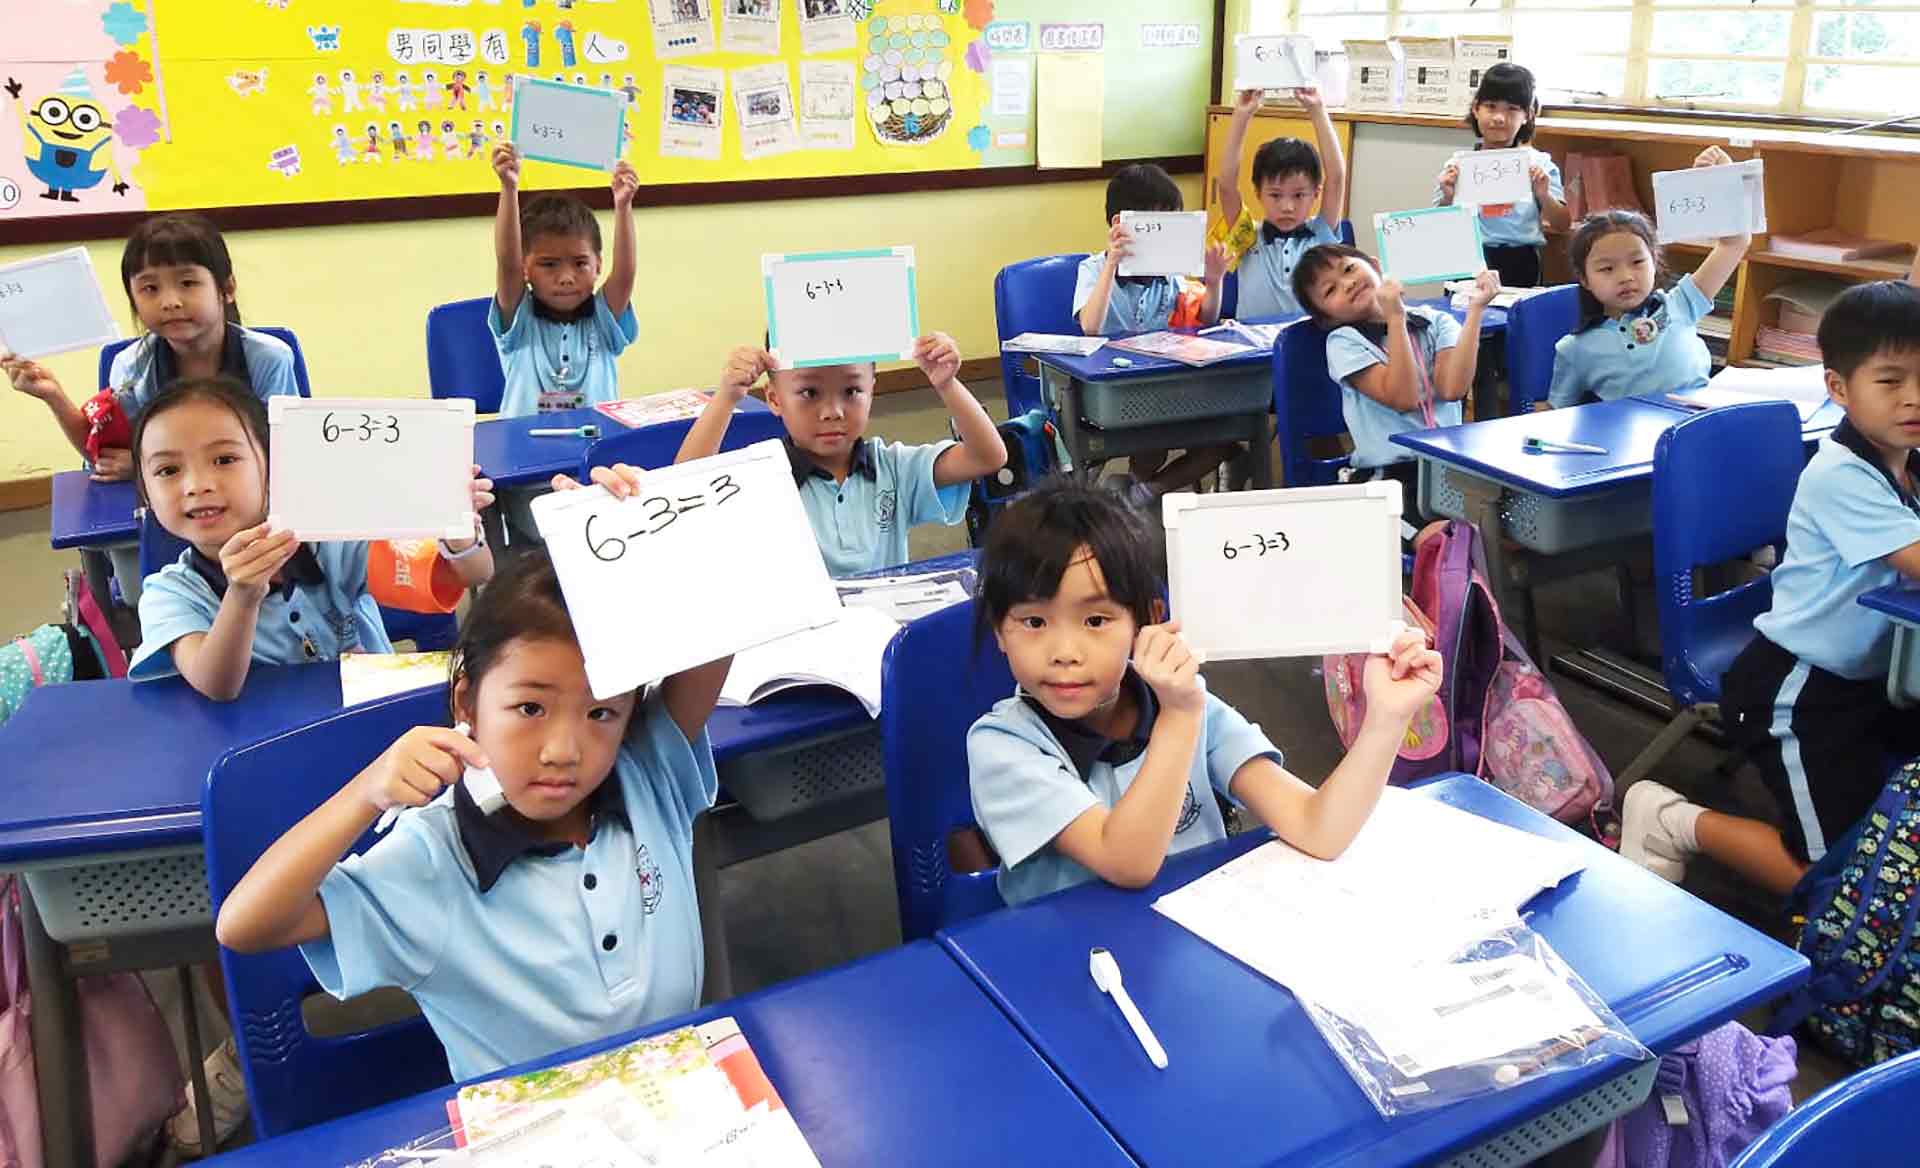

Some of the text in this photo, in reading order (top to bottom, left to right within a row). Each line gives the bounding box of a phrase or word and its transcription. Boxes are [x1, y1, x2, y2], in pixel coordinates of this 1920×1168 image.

[322, 411, 400, 443] 6-3=3
[585, 474, 742, 562] 6-3=3
[1223, 531, 1290, 560] 6-3=3
